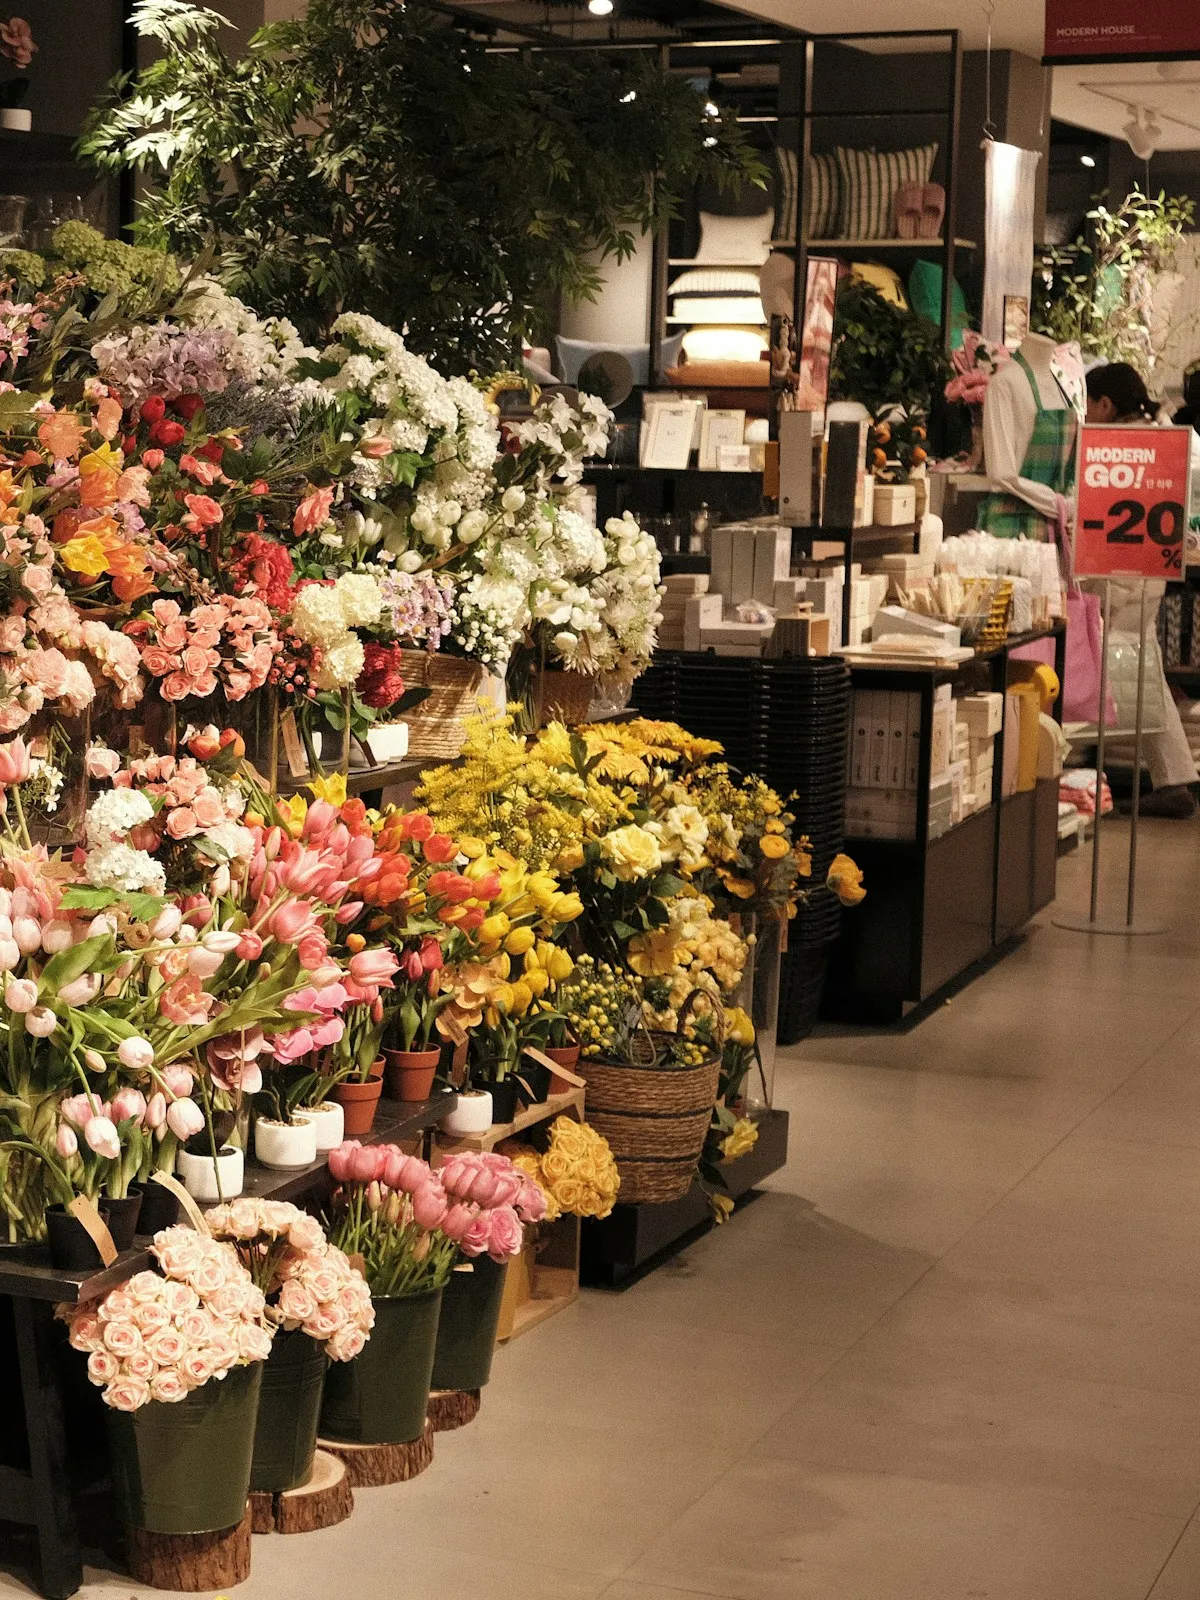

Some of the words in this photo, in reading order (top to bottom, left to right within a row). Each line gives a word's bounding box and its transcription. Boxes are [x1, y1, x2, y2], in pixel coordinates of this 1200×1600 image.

[1057, 27, 1098, 36] MODERN
[1101, 25, 1135, 34] HOUSE
[1086, 447, 1156, 463] MODERN
[1084, 463, 1145, 489] GO!
